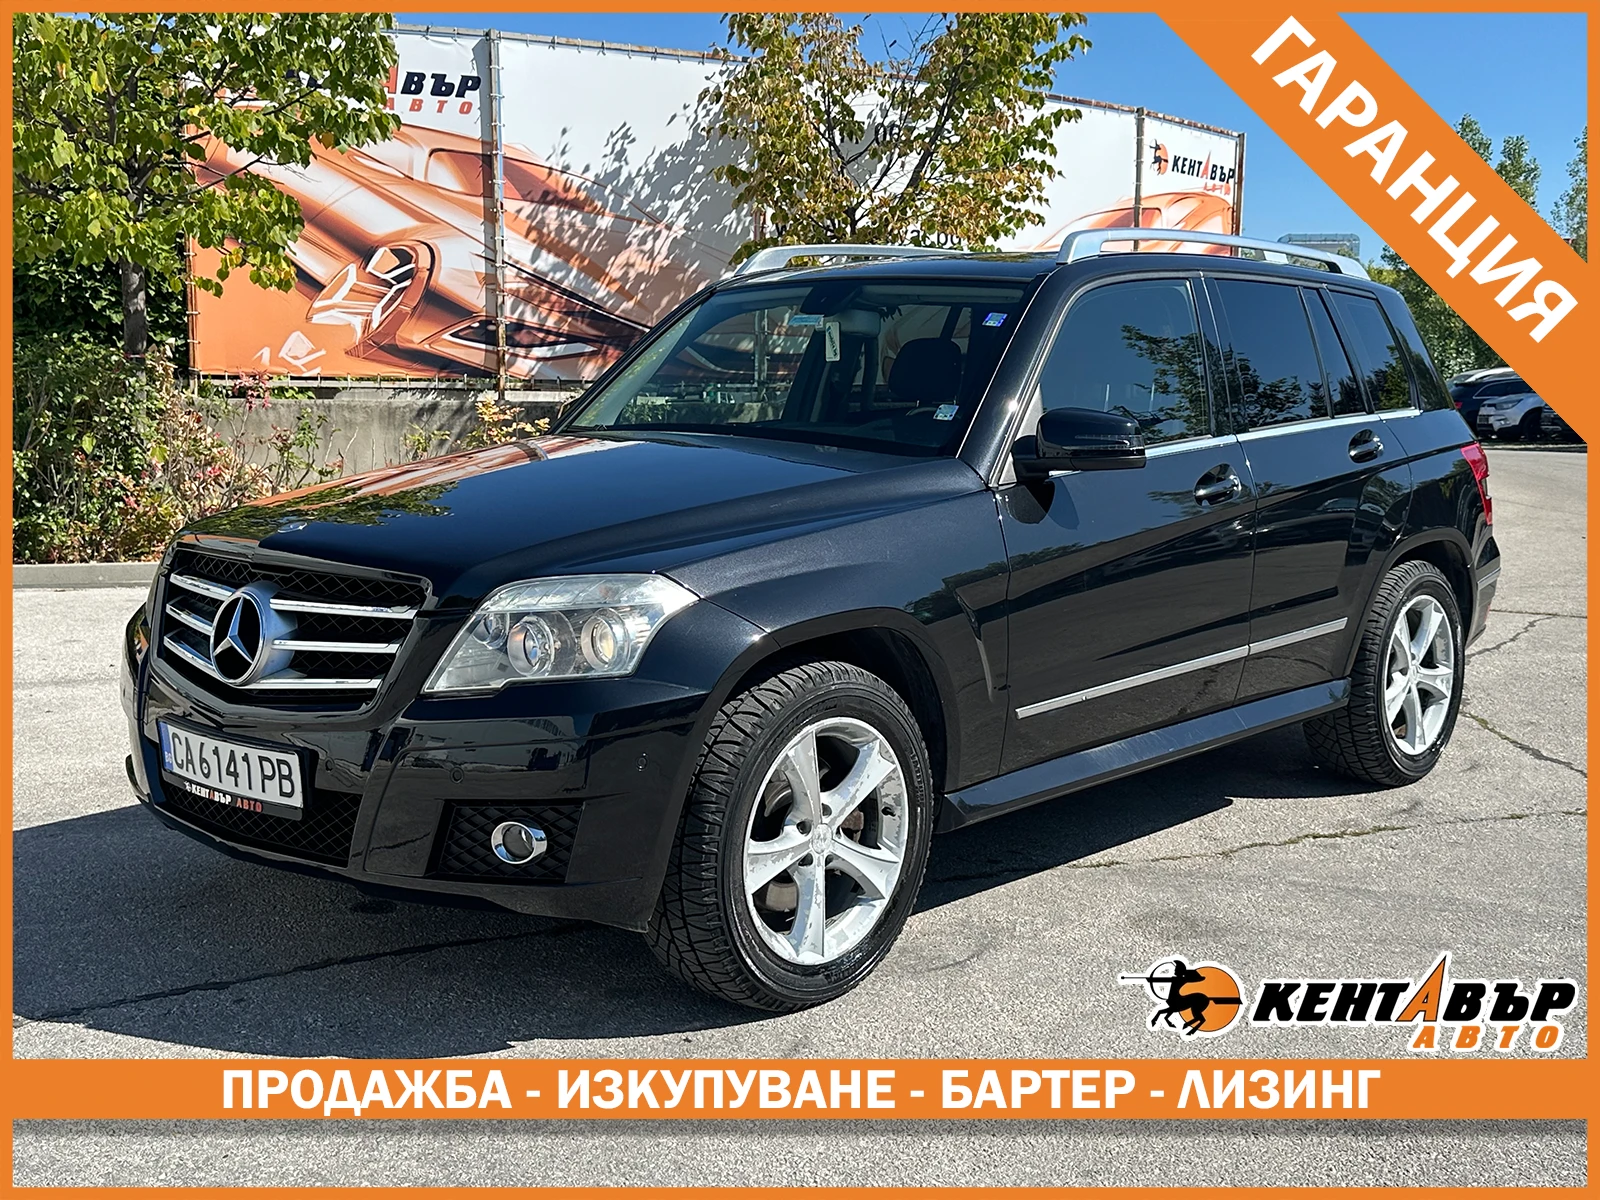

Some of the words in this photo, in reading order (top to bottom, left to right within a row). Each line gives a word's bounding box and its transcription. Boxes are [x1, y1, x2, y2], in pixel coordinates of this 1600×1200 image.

[1171, 151, 1235, 184] КЕНТАВЪР
[191, 783, 232, 805] КЕНТАВЪР
[236, 798, 263, 812] АВТО
